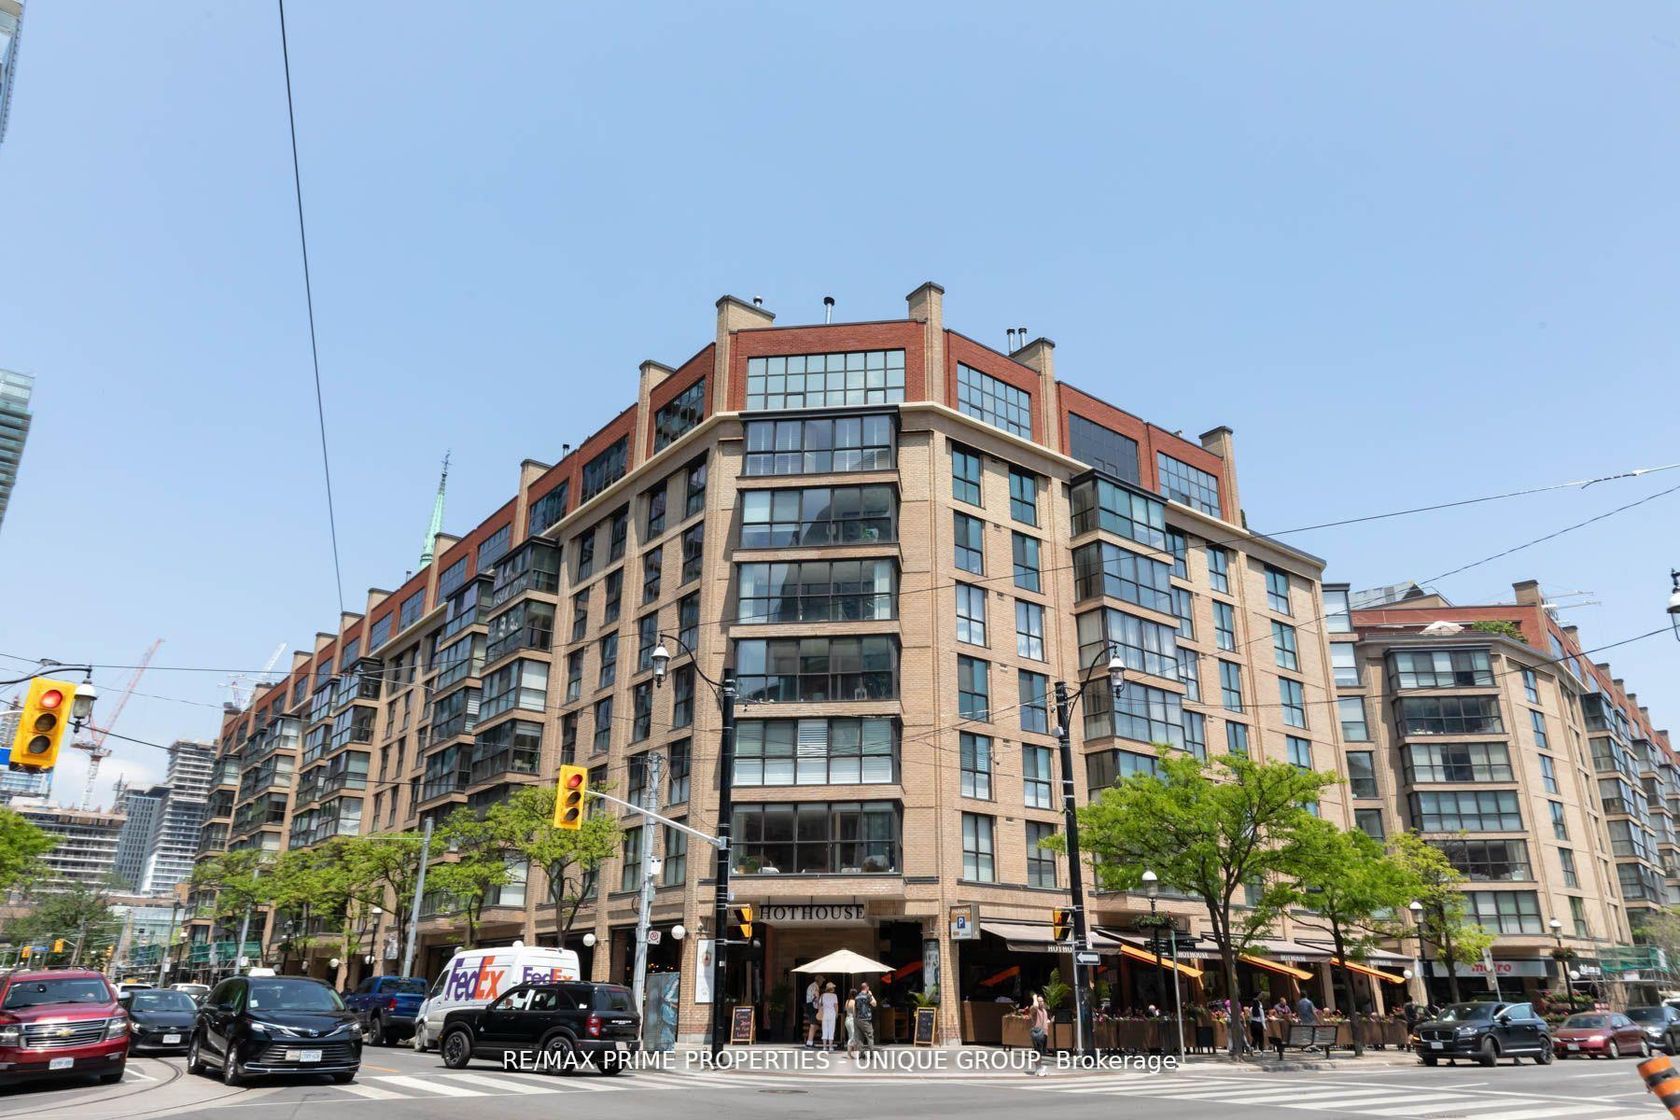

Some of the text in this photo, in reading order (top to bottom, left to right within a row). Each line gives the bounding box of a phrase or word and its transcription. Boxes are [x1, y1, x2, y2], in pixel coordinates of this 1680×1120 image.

[759, 905, 865, 920] HOTHOUSE
[1047, 945, 1073, 953] HOTHO
[444, 955, 505, 1002] FedEx
